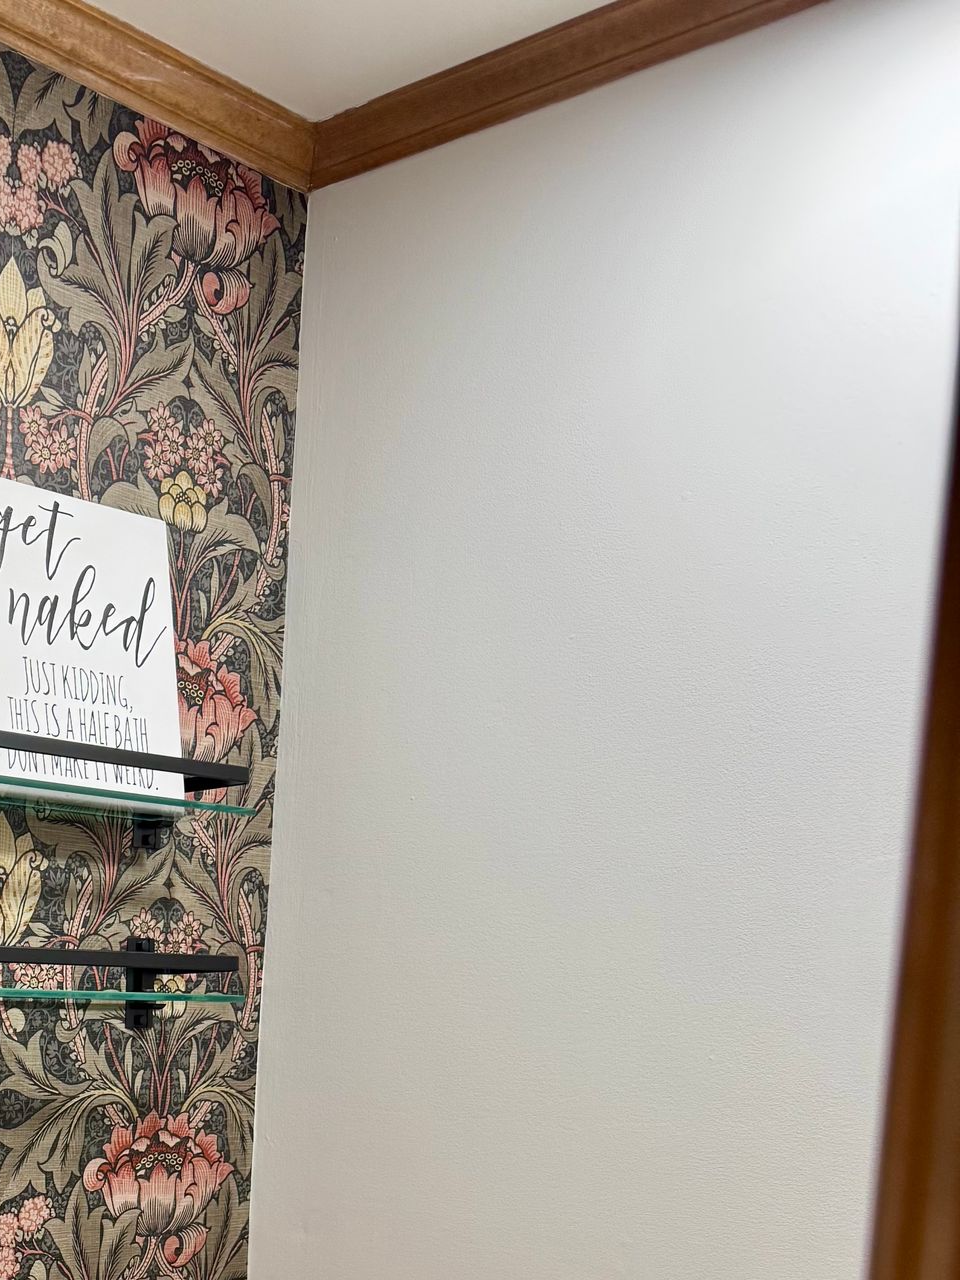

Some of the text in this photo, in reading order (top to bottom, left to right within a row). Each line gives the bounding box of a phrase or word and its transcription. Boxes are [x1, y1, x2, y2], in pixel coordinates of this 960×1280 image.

[8, 564, 168, 668] naked
[22, 656, 133, 713] JUST KIDDING,
[7, 696, 149, 754] THIS IS A HALF BATH
